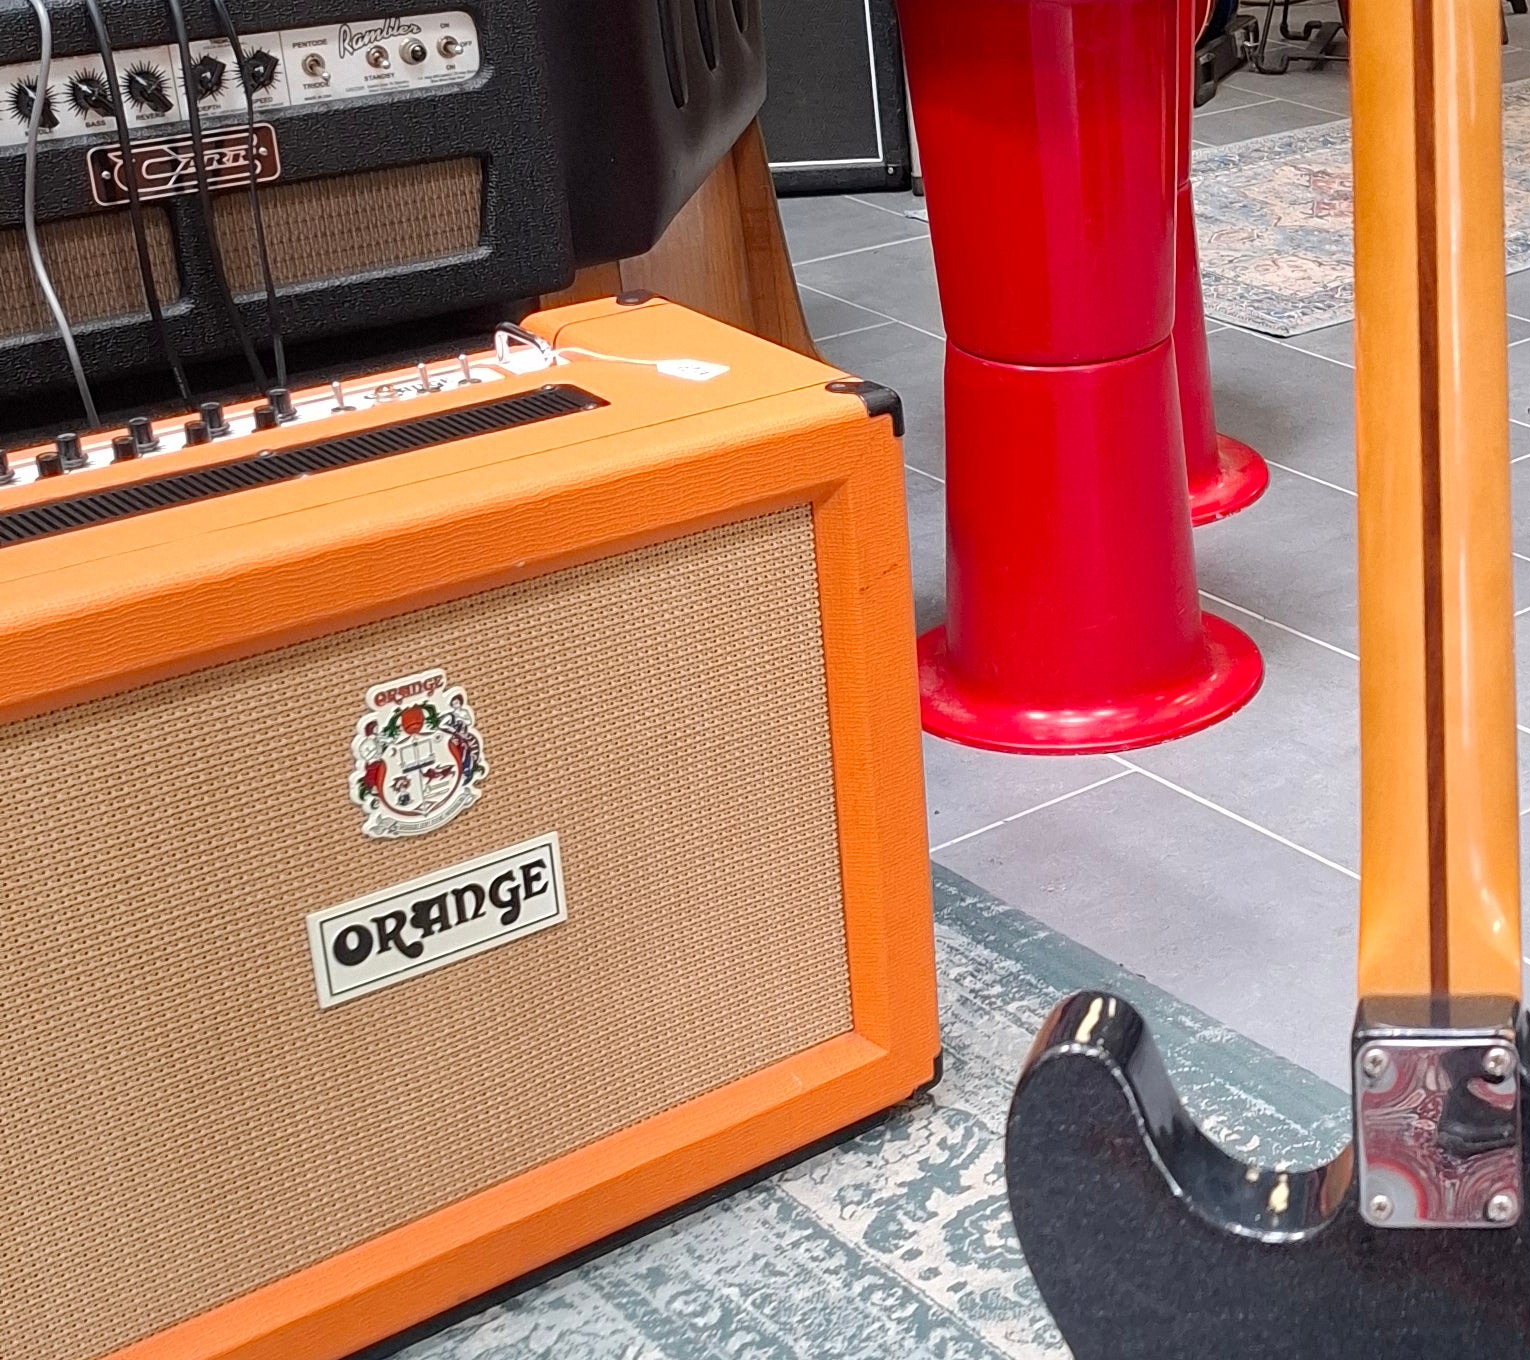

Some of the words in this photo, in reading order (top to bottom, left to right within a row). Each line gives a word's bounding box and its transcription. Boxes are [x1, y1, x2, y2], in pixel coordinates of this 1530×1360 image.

[292, 38, 328, 49] PENTODE
[338, 18, 422, 60] Rambler
[364, 72, 395, 82] STANDBY
[85, 120, 106, 129] BASS
[374, 674, 445, 708] ORANGE
[332, 857, 549, 967] ORANGE
